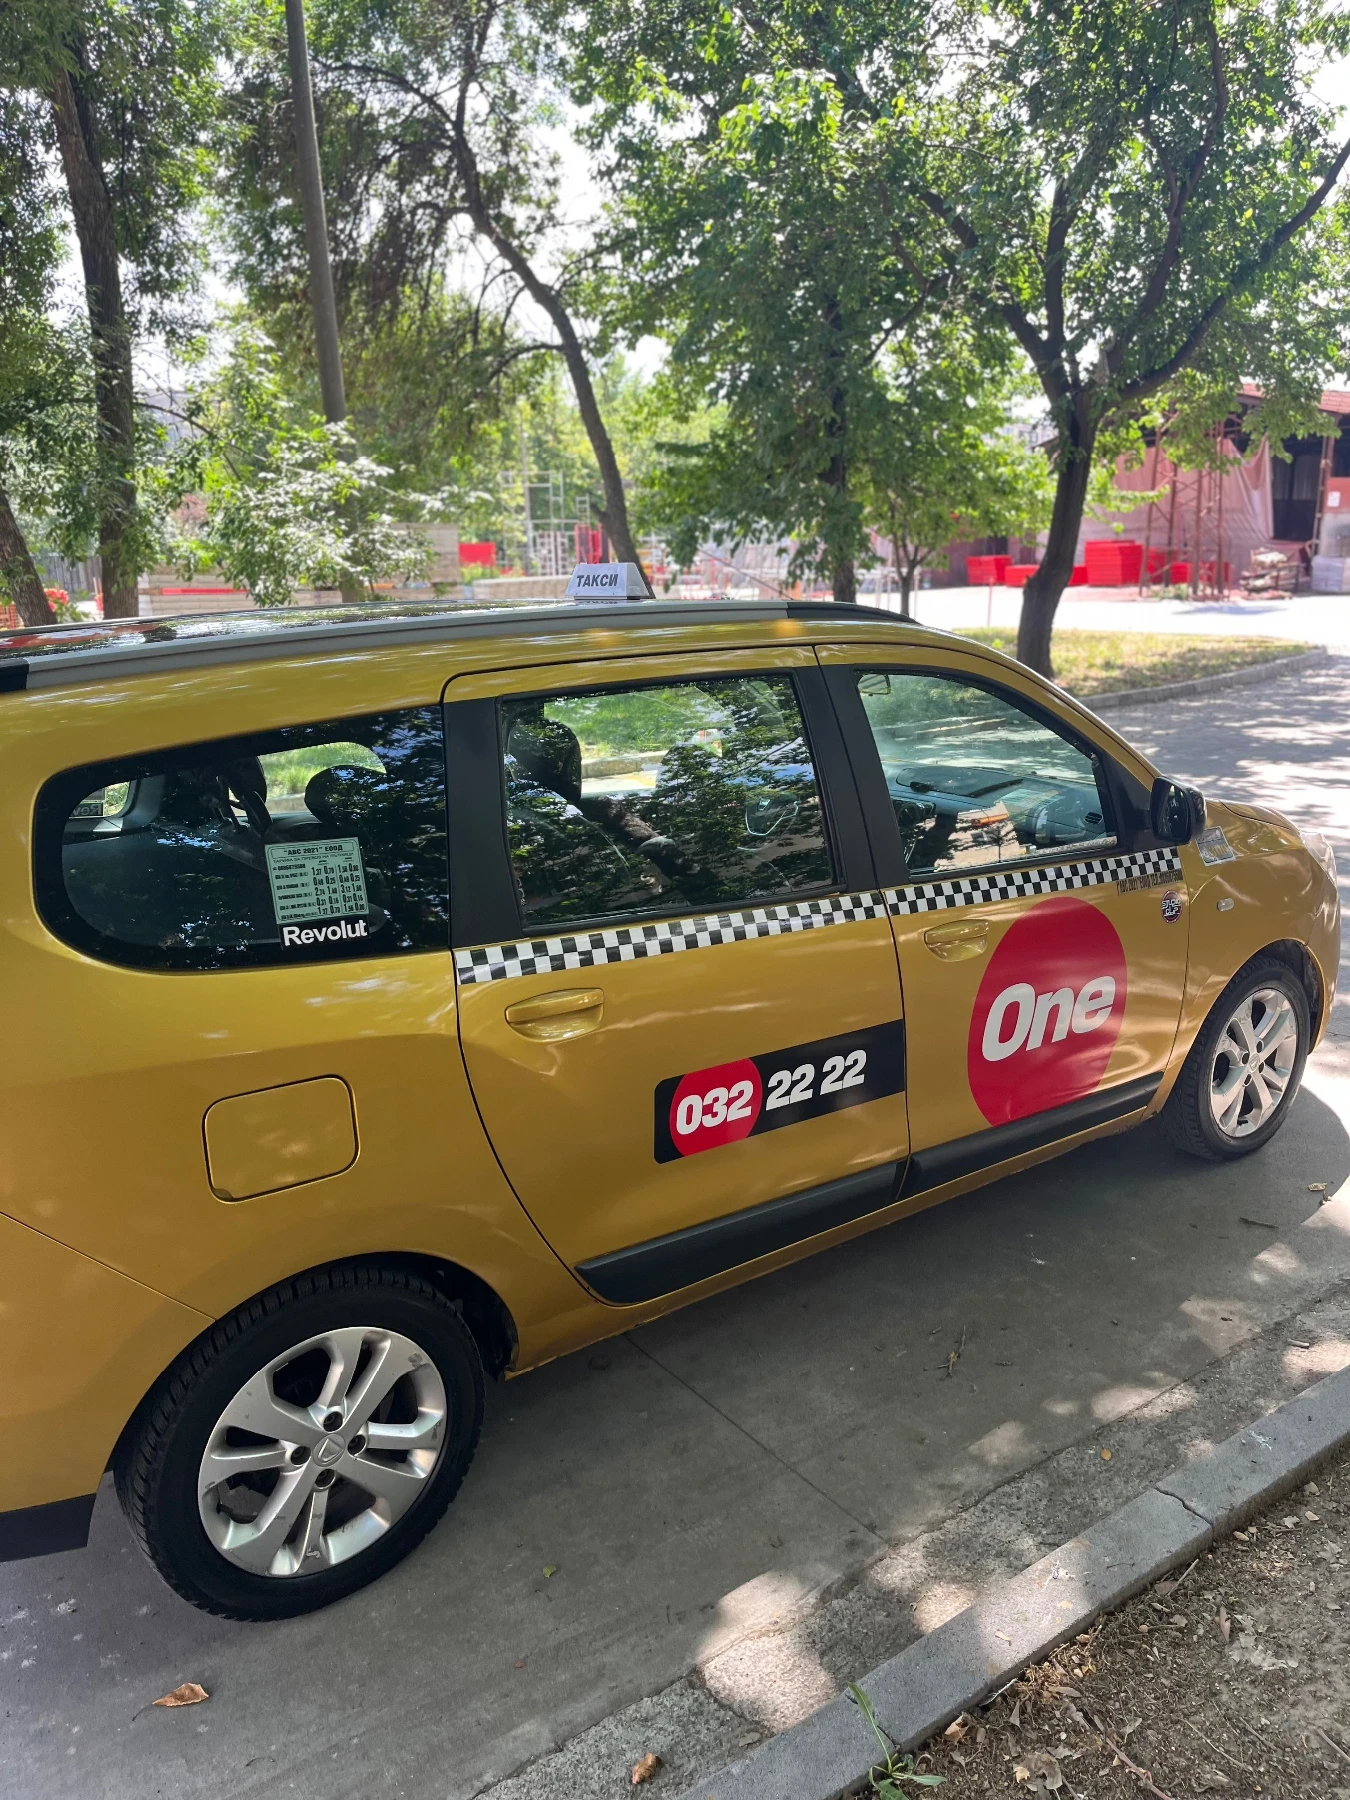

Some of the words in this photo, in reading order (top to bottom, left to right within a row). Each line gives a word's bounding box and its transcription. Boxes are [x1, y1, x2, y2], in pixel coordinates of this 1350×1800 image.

[576, 574, 619, 587] ТАКСИ
[324, 844, 343, 852] ЕООД
[282, 920, 368, 946] Revolut
[982, 976, 1116, 1062] One
[676, 1080, 754, 1136] 032
[766, 1064, 815, 1111] 22
[820, 1049, 867, 1096] 22
